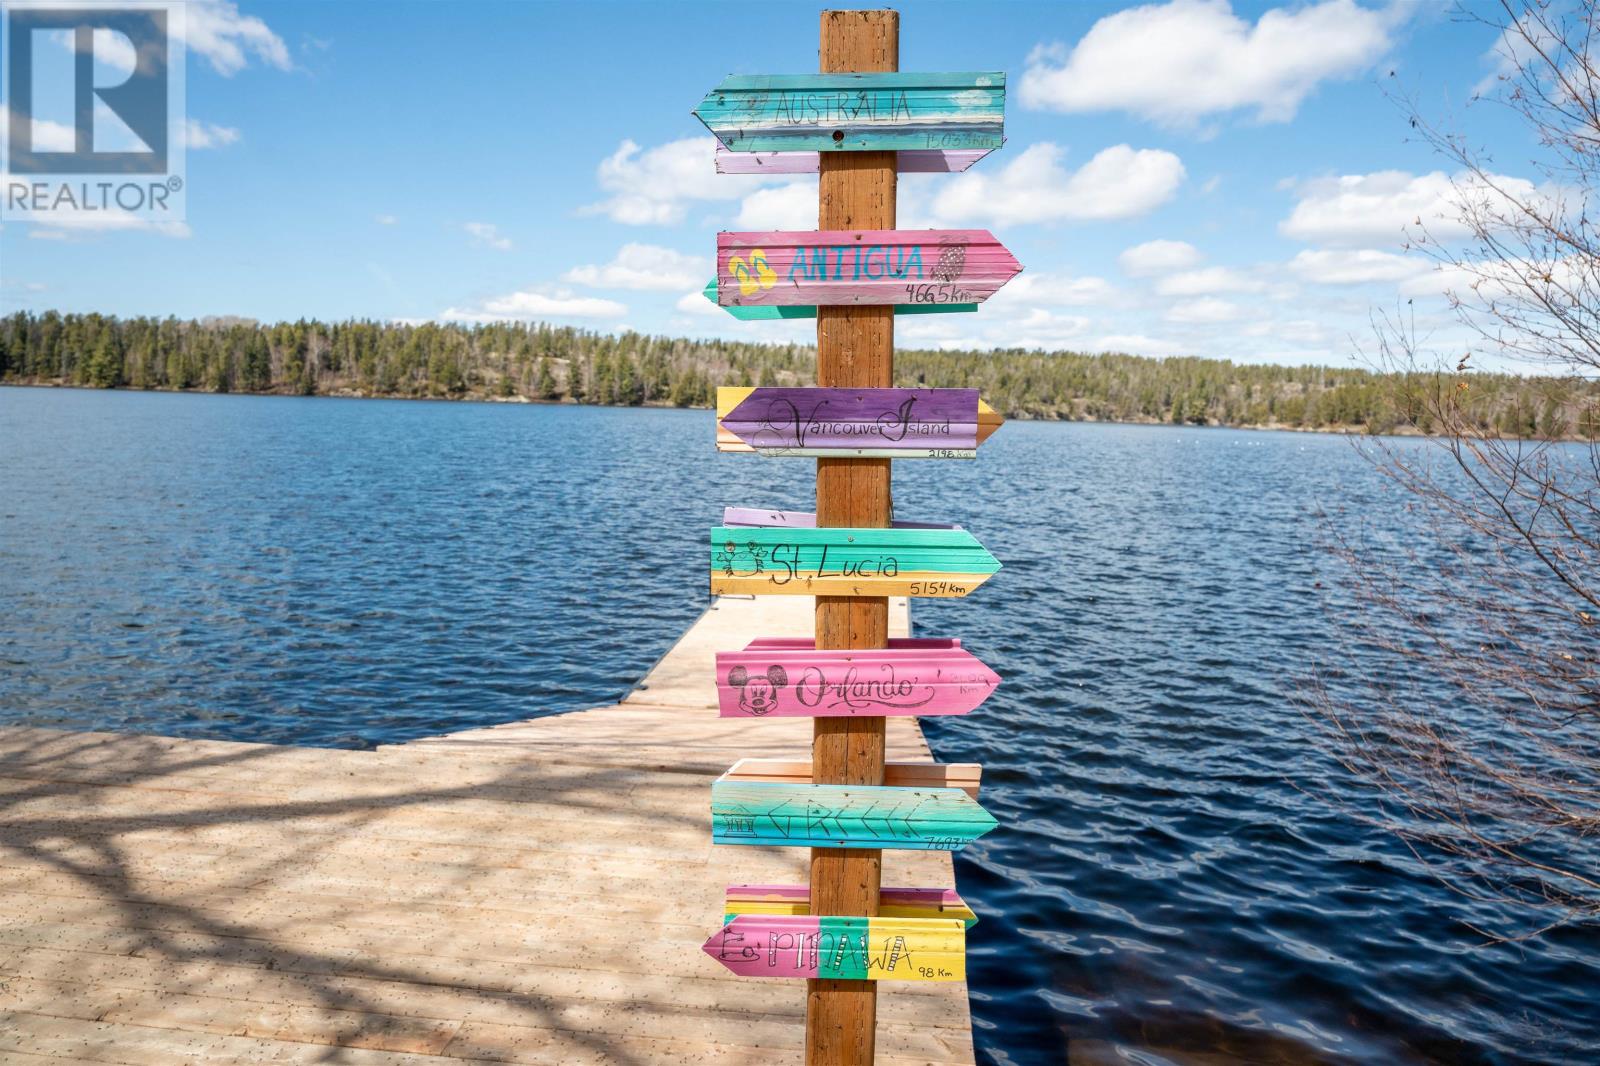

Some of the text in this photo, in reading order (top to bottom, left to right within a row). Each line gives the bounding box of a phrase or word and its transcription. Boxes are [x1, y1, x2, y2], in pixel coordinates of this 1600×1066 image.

[776, 90, 911, 124] AUSTRALIA
[788, 246, 923, 281] ANTIGUA
[768, 394, 950, 448] Vancouver Island
[817, 544, 898, 578] Lucia
[918, 966, 935, 978] 98
